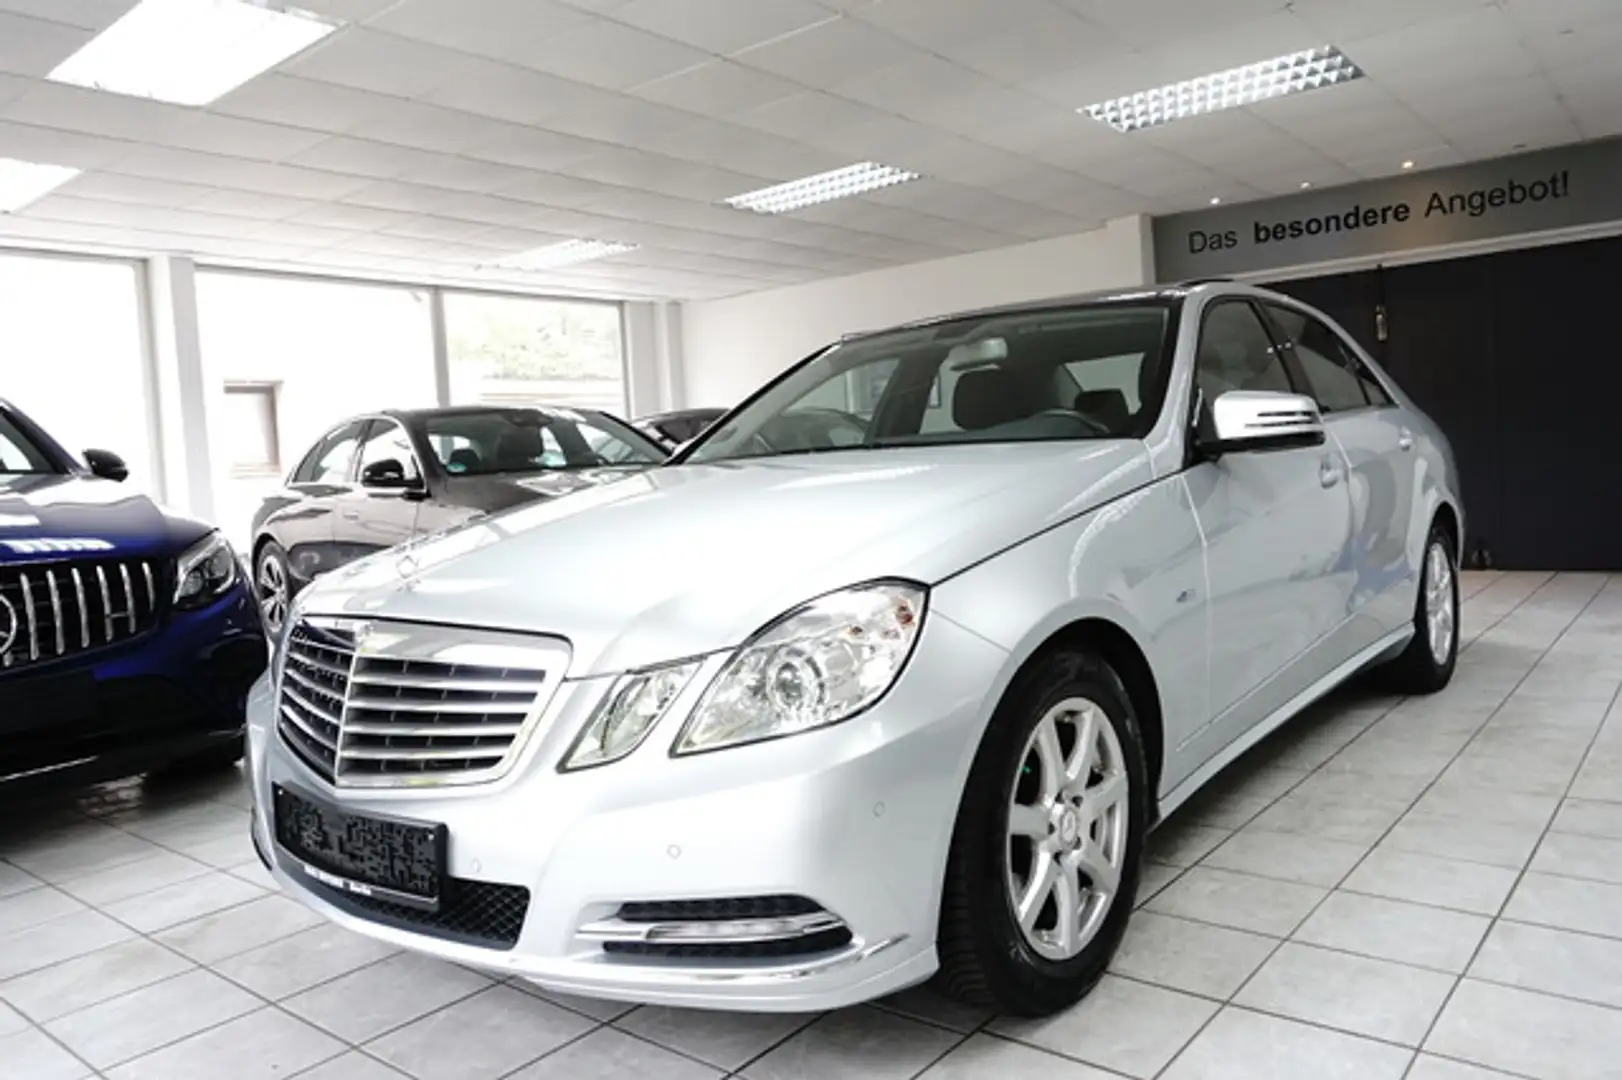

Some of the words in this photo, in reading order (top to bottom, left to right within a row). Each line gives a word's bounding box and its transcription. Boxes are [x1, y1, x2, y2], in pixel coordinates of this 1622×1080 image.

[1188, 229, 1238, 253] Das
[1253, 202, 1410, 244] besondere
[1425, 170, 1569, 217] Angebot!
